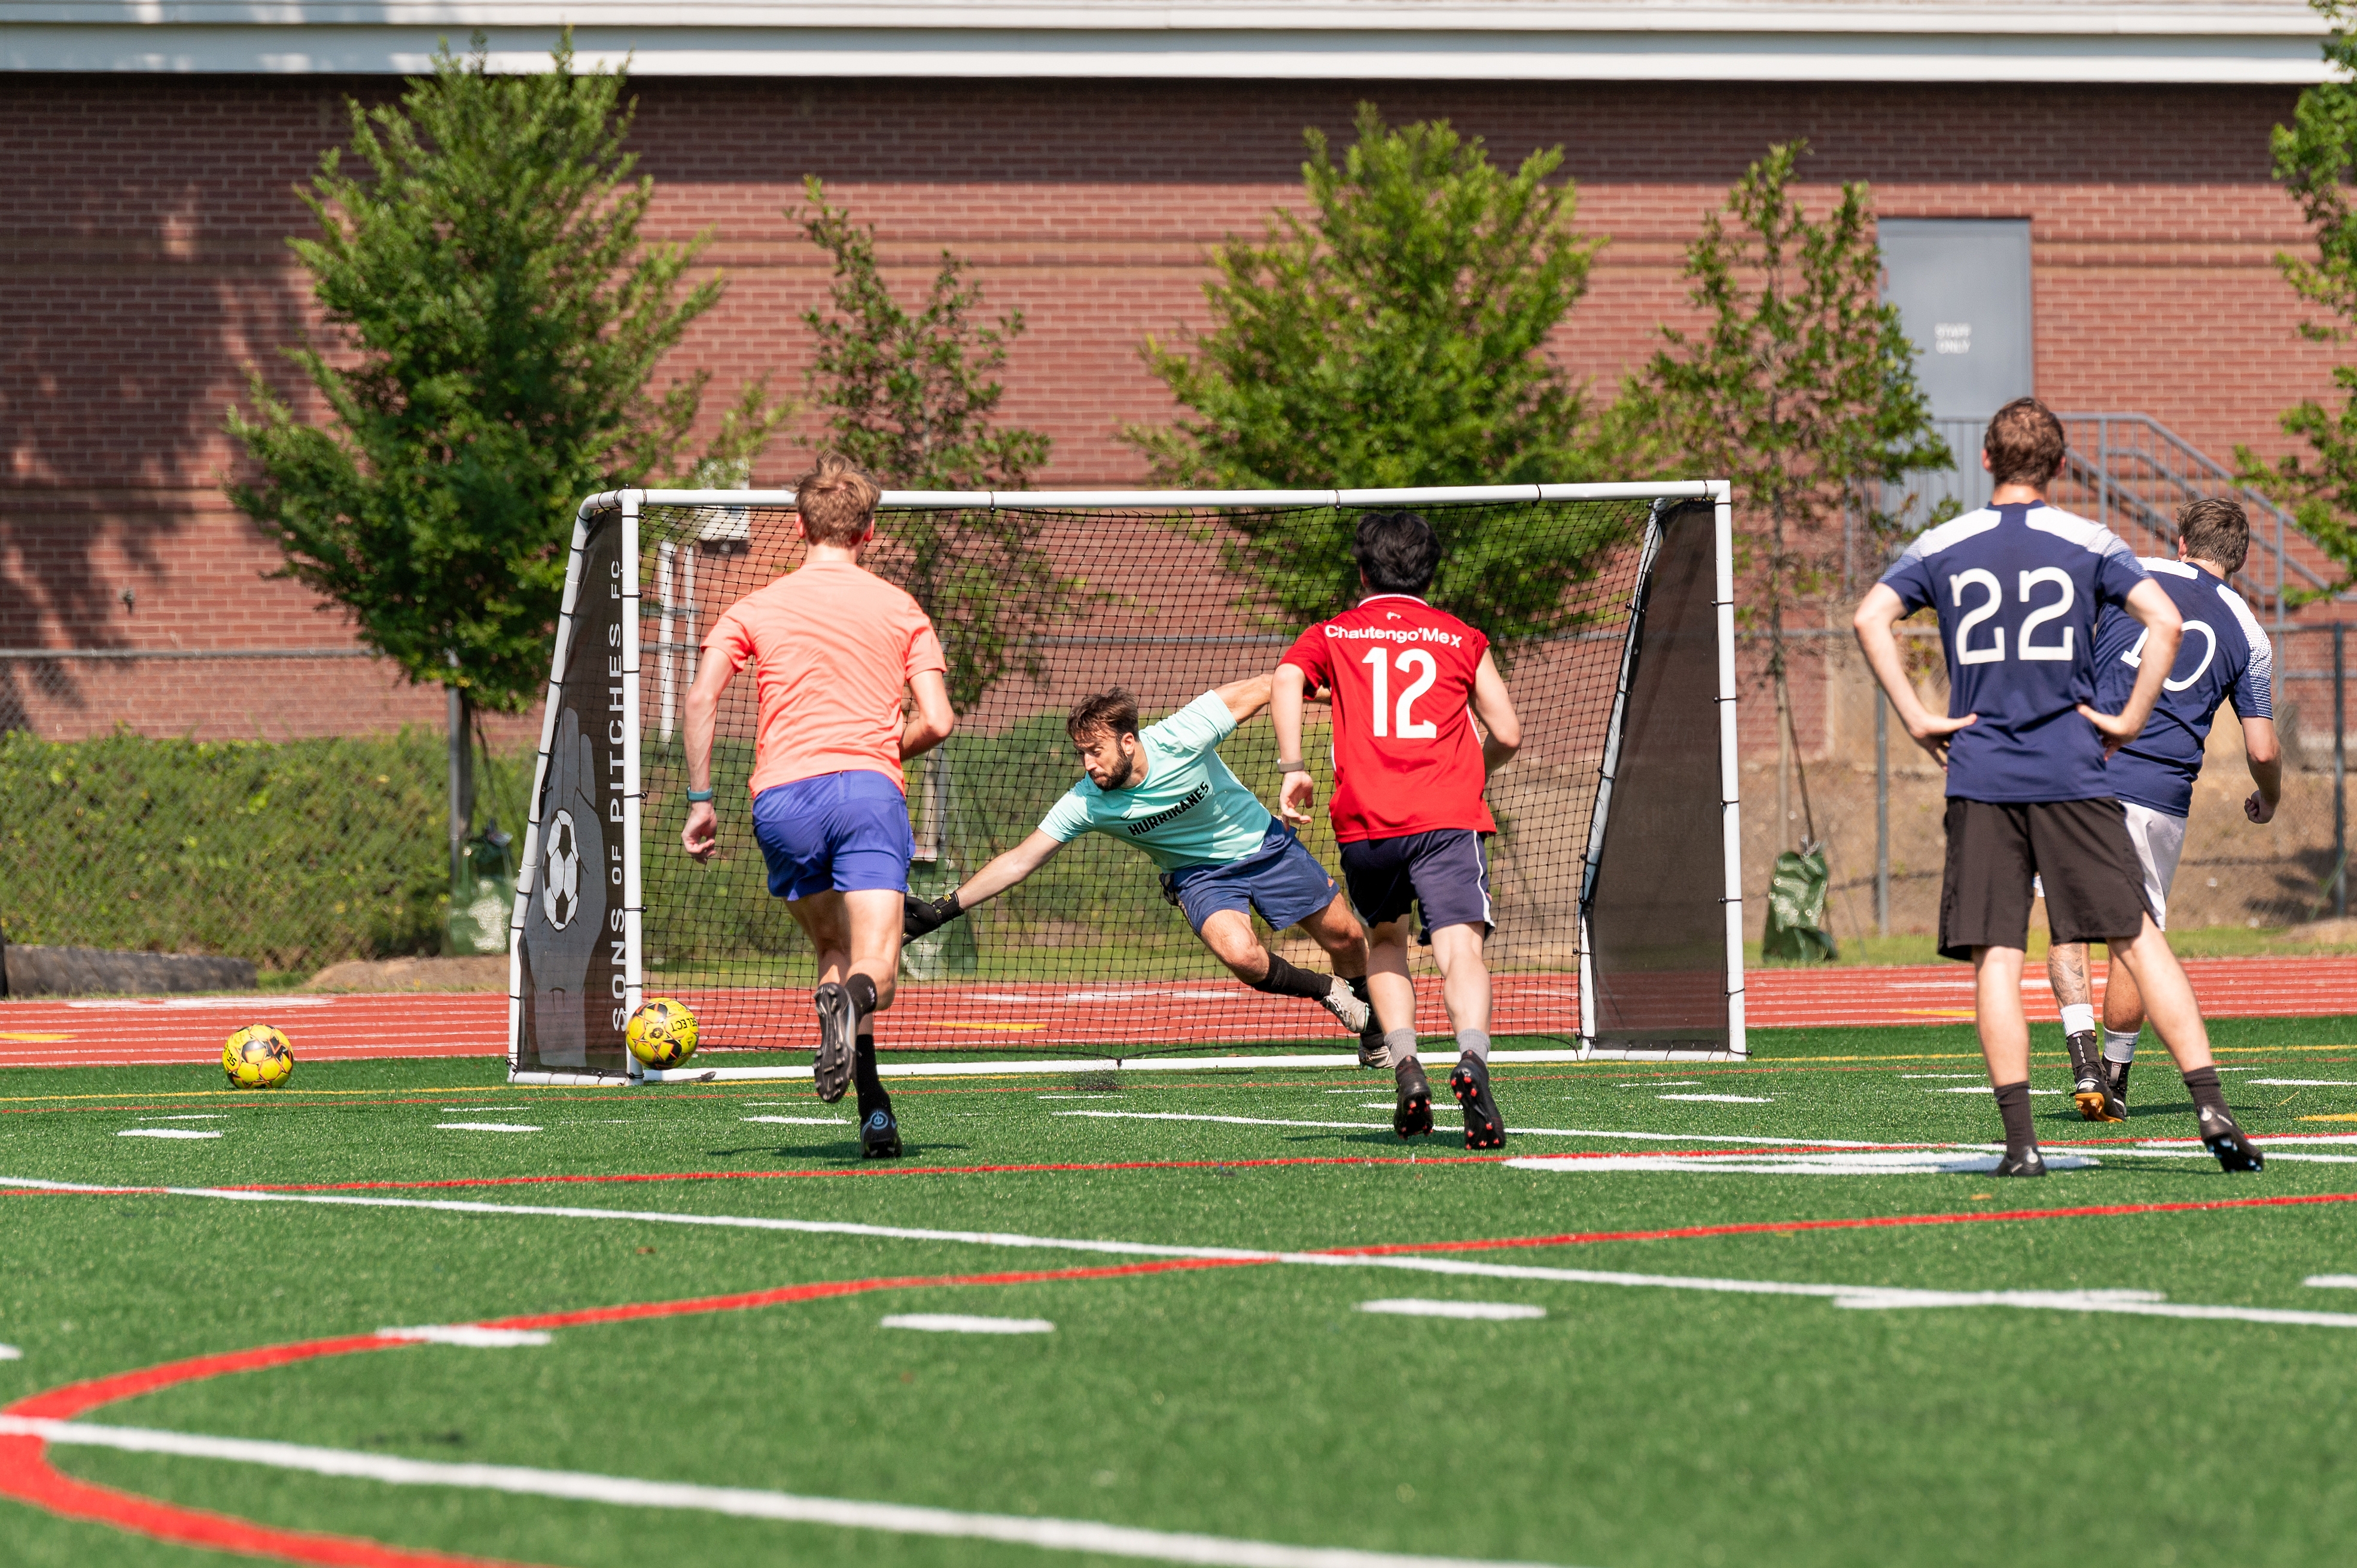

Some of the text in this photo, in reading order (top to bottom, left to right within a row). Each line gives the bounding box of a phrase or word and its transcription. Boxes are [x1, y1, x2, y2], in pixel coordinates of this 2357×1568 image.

[1949, 566, 2075, 665] 22
[1362, 647, 1437, 739] 12
[609, 561, 626, 1032] SONS OF PITCHES FC
[1128, 781, 1209, 836] HURRIKANES
